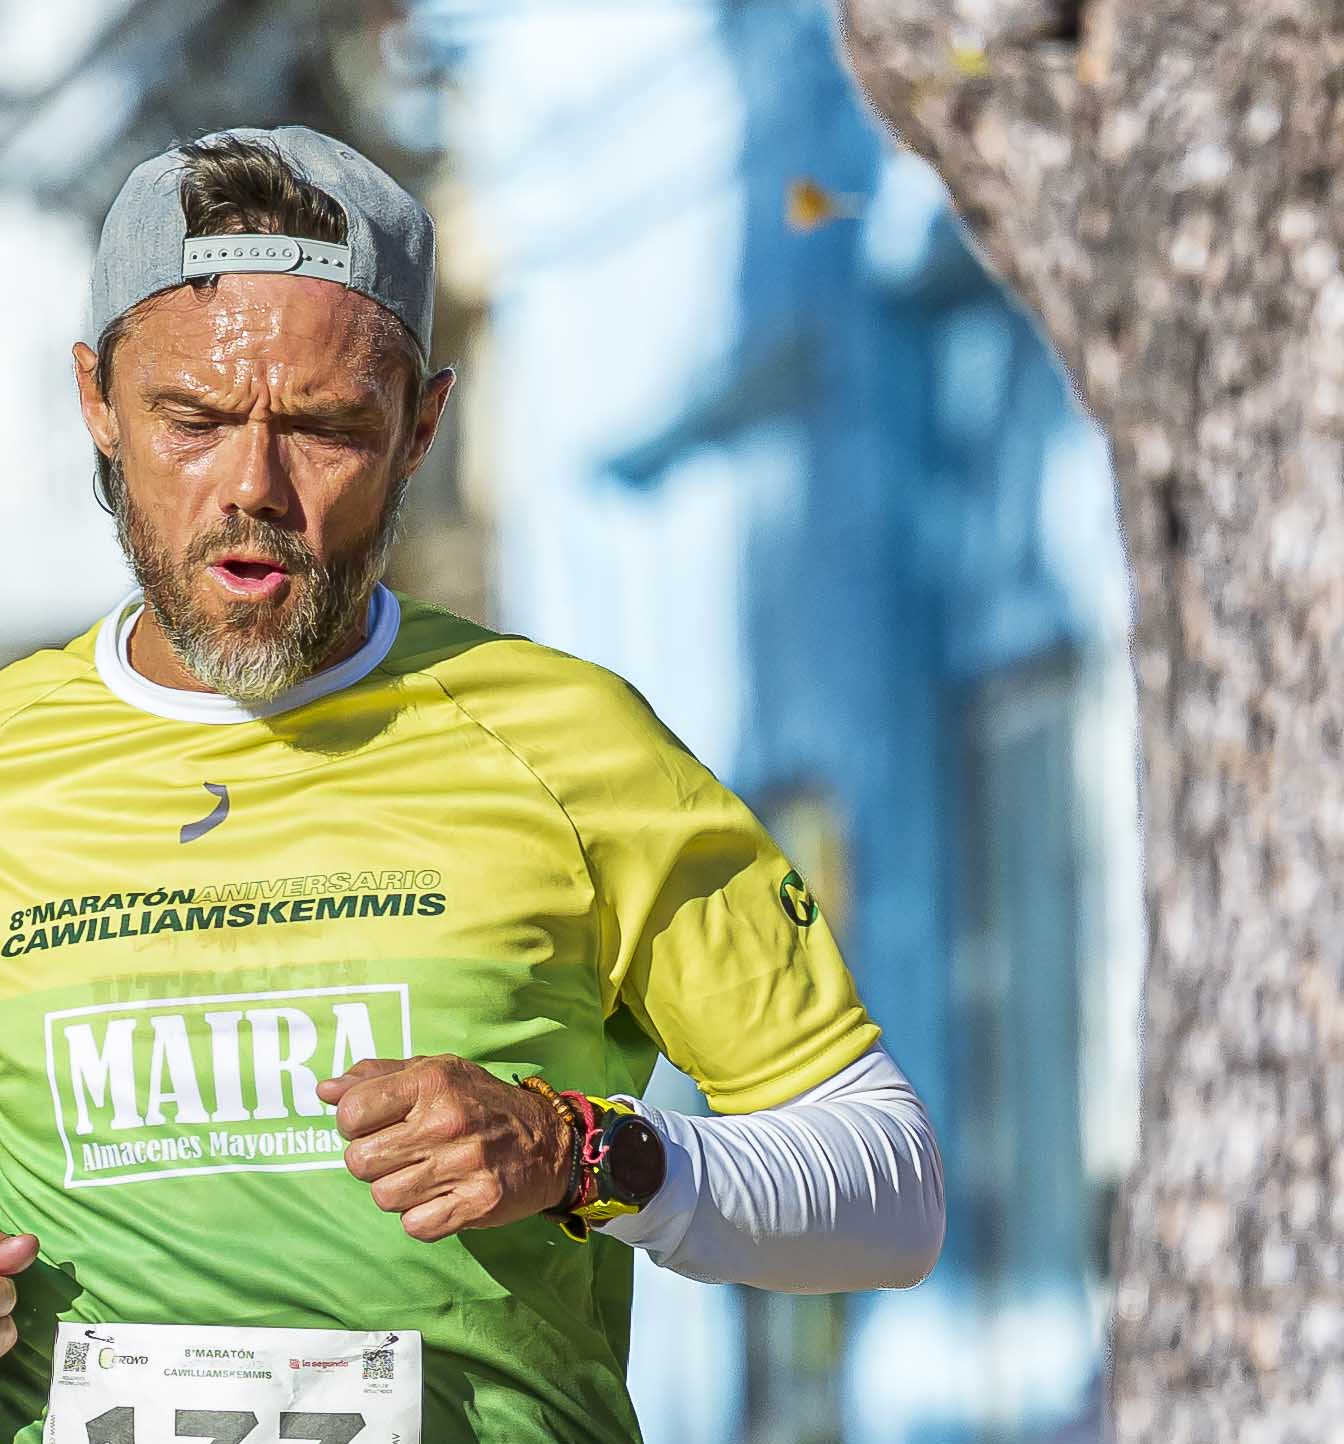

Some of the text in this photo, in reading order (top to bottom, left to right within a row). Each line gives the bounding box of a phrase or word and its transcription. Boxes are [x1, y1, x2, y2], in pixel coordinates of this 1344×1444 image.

[192, 869, 442, 904] ANIVERSARIO
[0, 892, 447, 958] CAWILLIAMSKEMMIS
[64, 1001, 380, 1136] MAIRA
[83, 1126, 344, 1172] Almacenes Mayoristas
